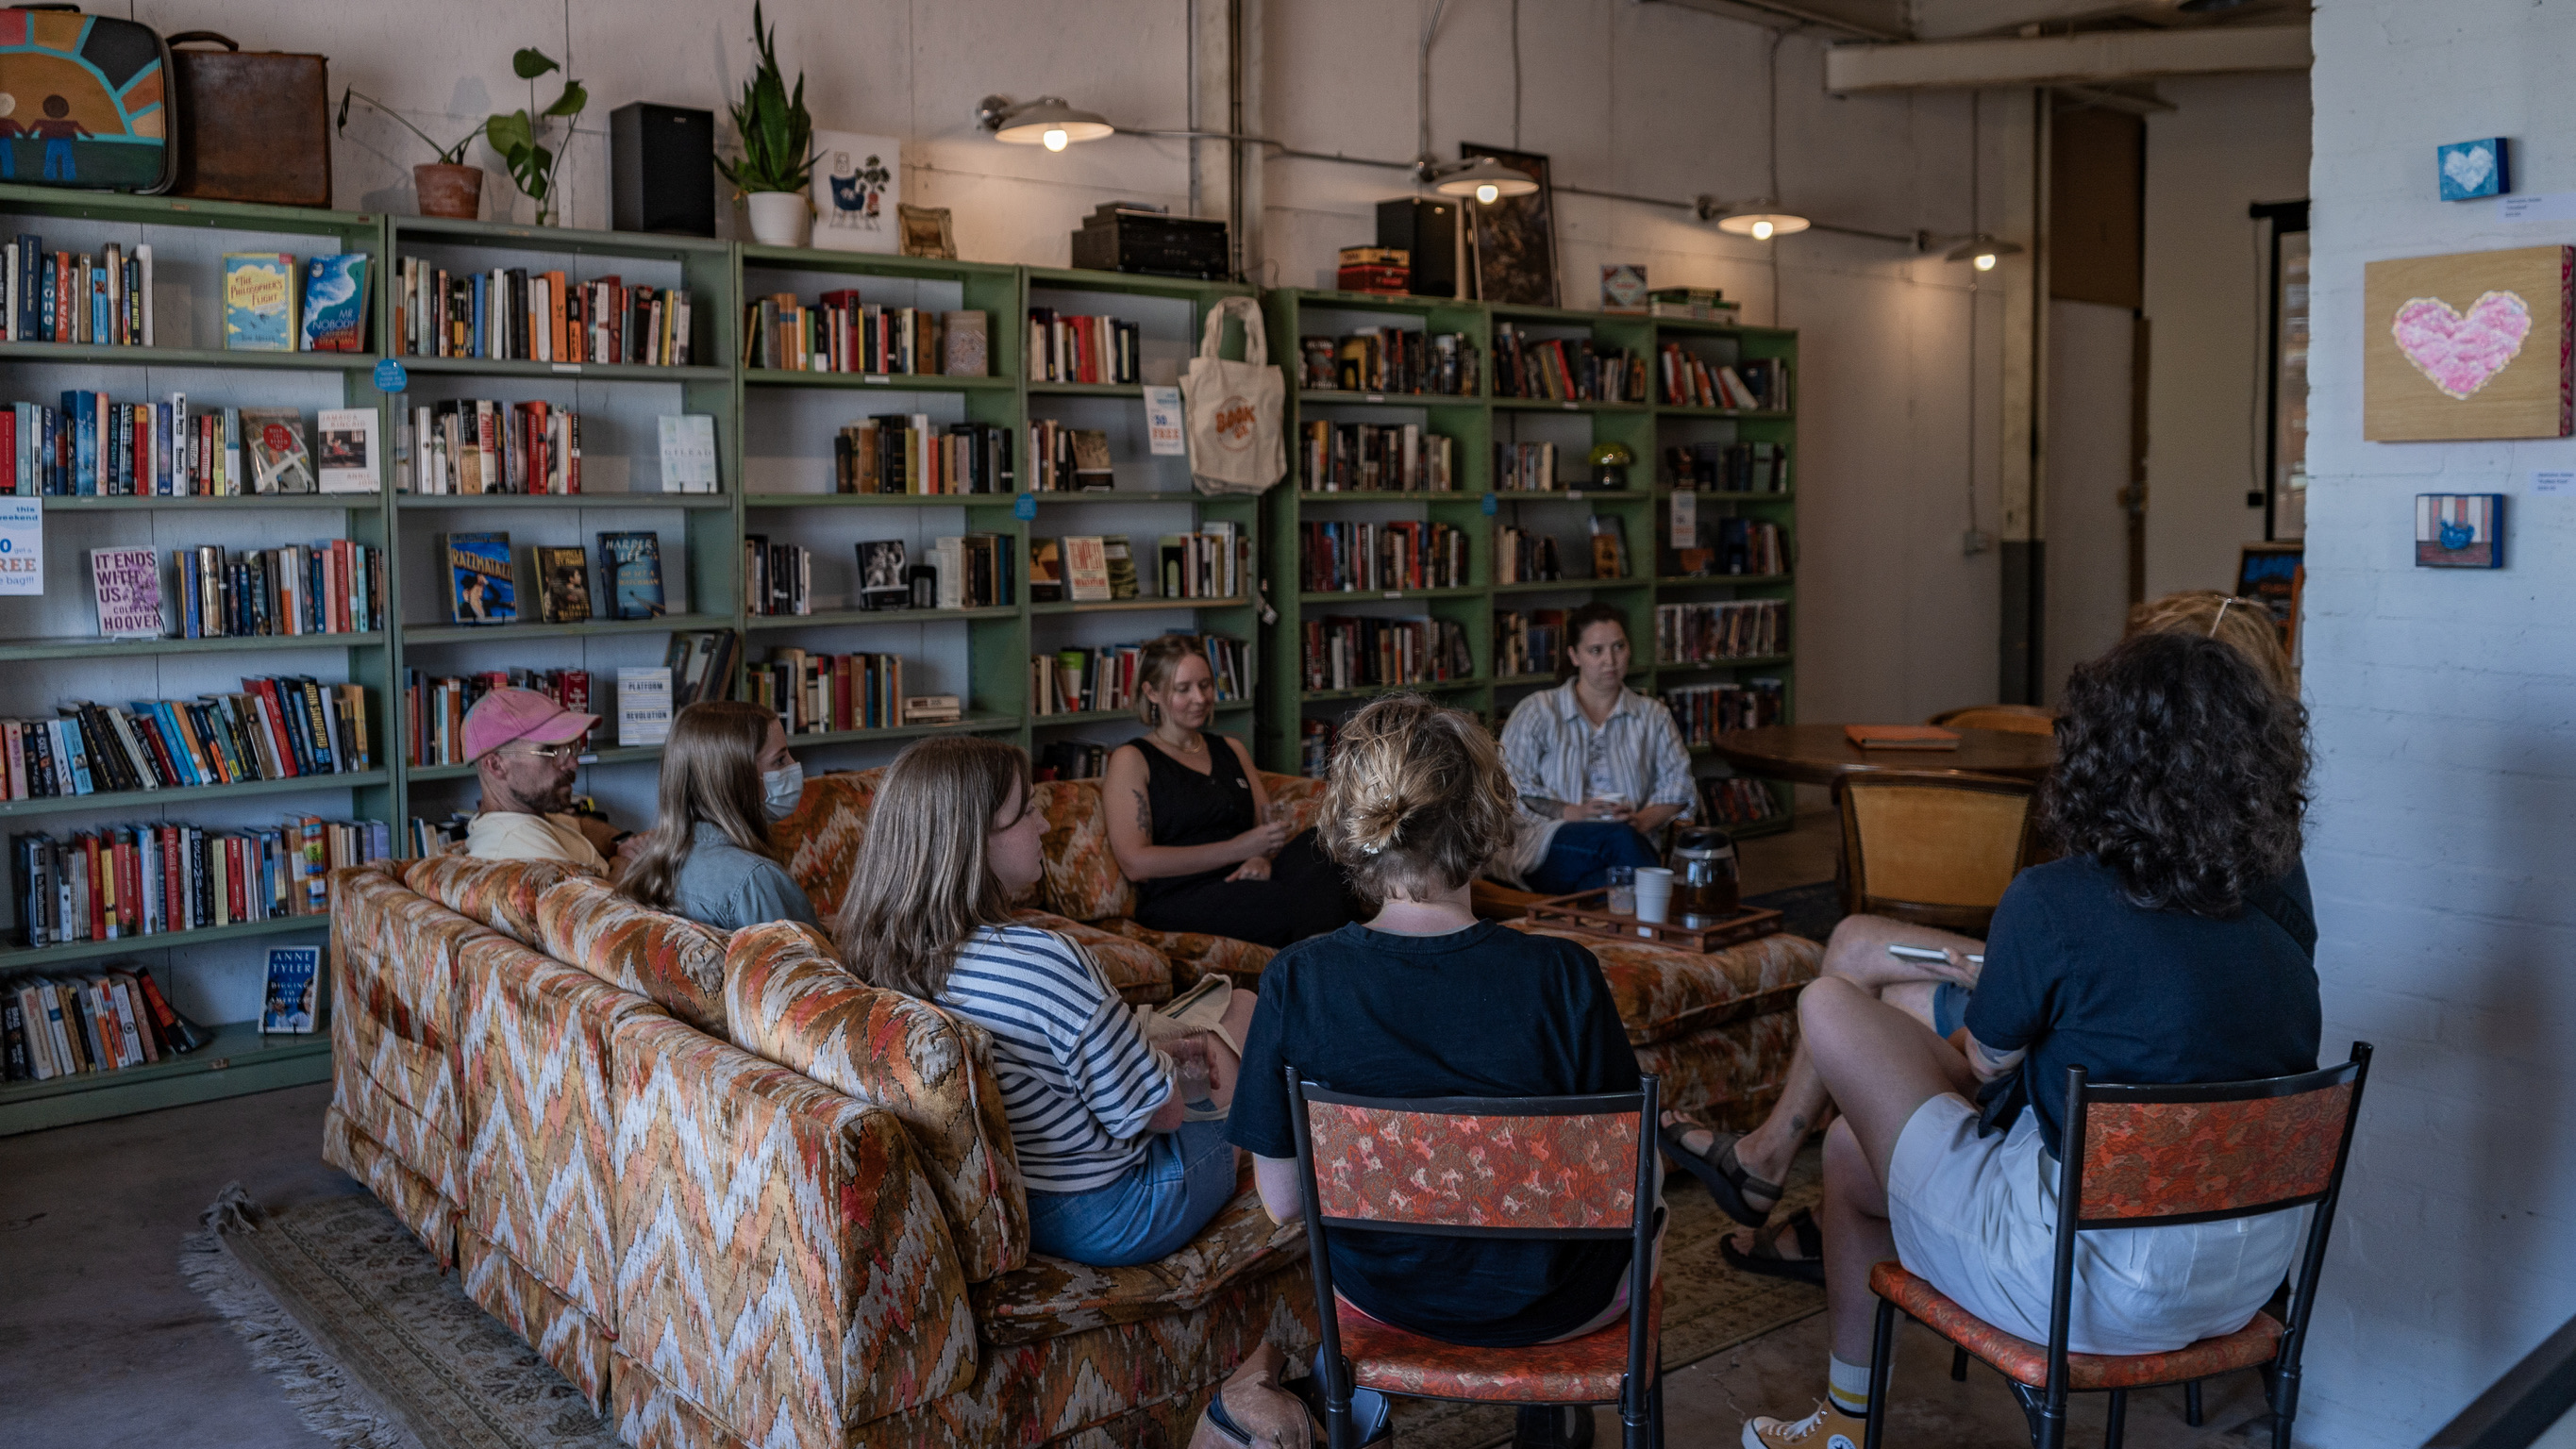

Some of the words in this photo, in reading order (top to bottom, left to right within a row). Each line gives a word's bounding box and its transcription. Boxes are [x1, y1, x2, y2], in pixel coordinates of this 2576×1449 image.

[235, 275, 252, 287] THE
[251, 294, 277, 307] FLIGHT
[339, 309, 353, 318] MR
[312, 319, 355, 331] NOBODY
[1215, 407, 1255, 434] BOOK
[1152, 427, 1179, 440] FREE
[605, 539, 652, 550] HARPER
[95, 555, 109, 569] IT
[114, 552, 156, 568] ENDS
[620, 552, 642, 562] LEE
[452, 548, 512, 581] RAZZMATAZZ
[6, 575, 34, 586] bag!!!
[97, 570, 139, 586] WITH
[99, 587, 121, 603] US
[104, 616, 161, 631] HOOVER
[628, 682, 663, 690] PLATFORM
[305, 683, 319, 705] JOHN
[626, 711, 667, 719] REVOLUTION
[309, 706, 329, 749] SANDFORD
[167, 833, 176, 872] FRAGILE
[275, 951, 311, 961] ANNE
[272, 963, 311, 974] TYLER
[11, 1007, 21, 1028] BRAD
